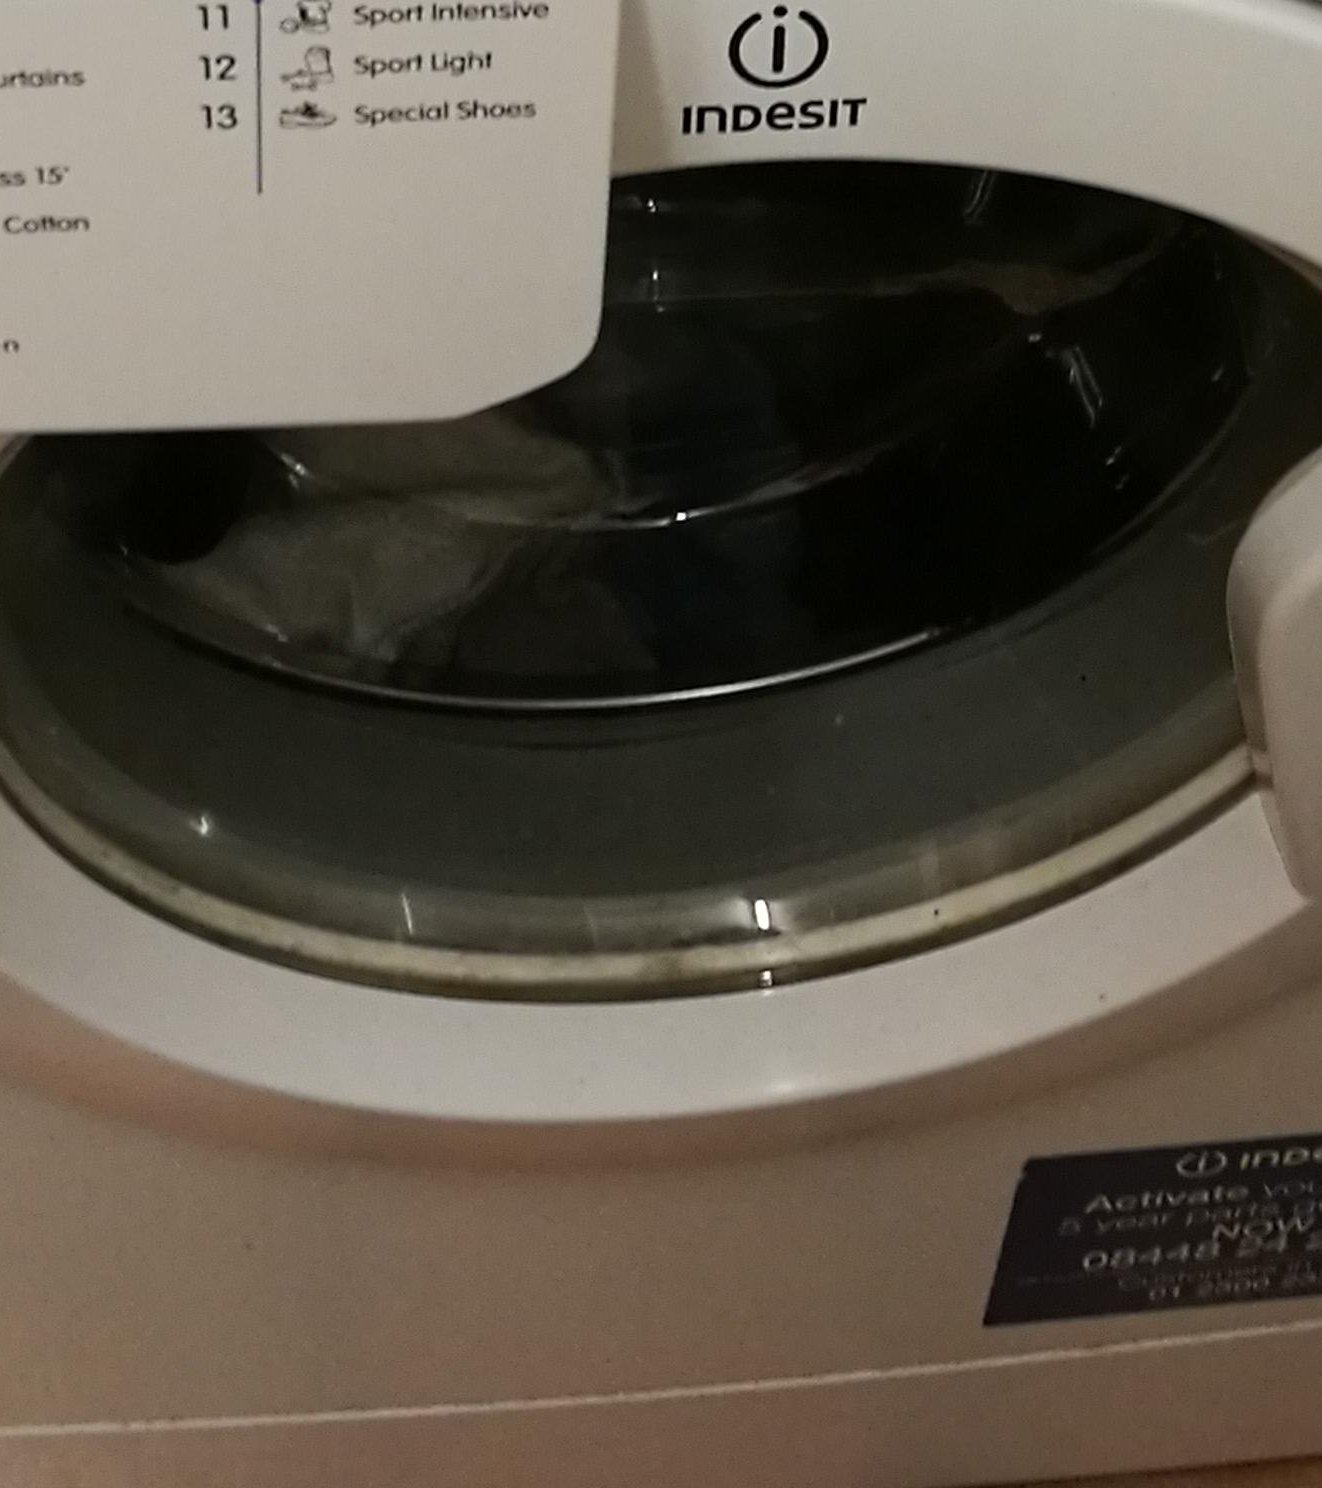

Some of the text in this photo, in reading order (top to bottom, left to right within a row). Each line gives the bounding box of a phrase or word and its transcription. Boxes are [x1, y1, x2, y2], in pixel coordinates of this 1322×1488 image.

[197, 0, 550, 31] 11 Sport Intensive
[198, 50, 493, 82] 12 Sport Light
[199, 99, 537, 131] 13 Special Shoes
[3, 213, 91, 235] Cotton
[1211, 1215, 1319, 1242] NOW
